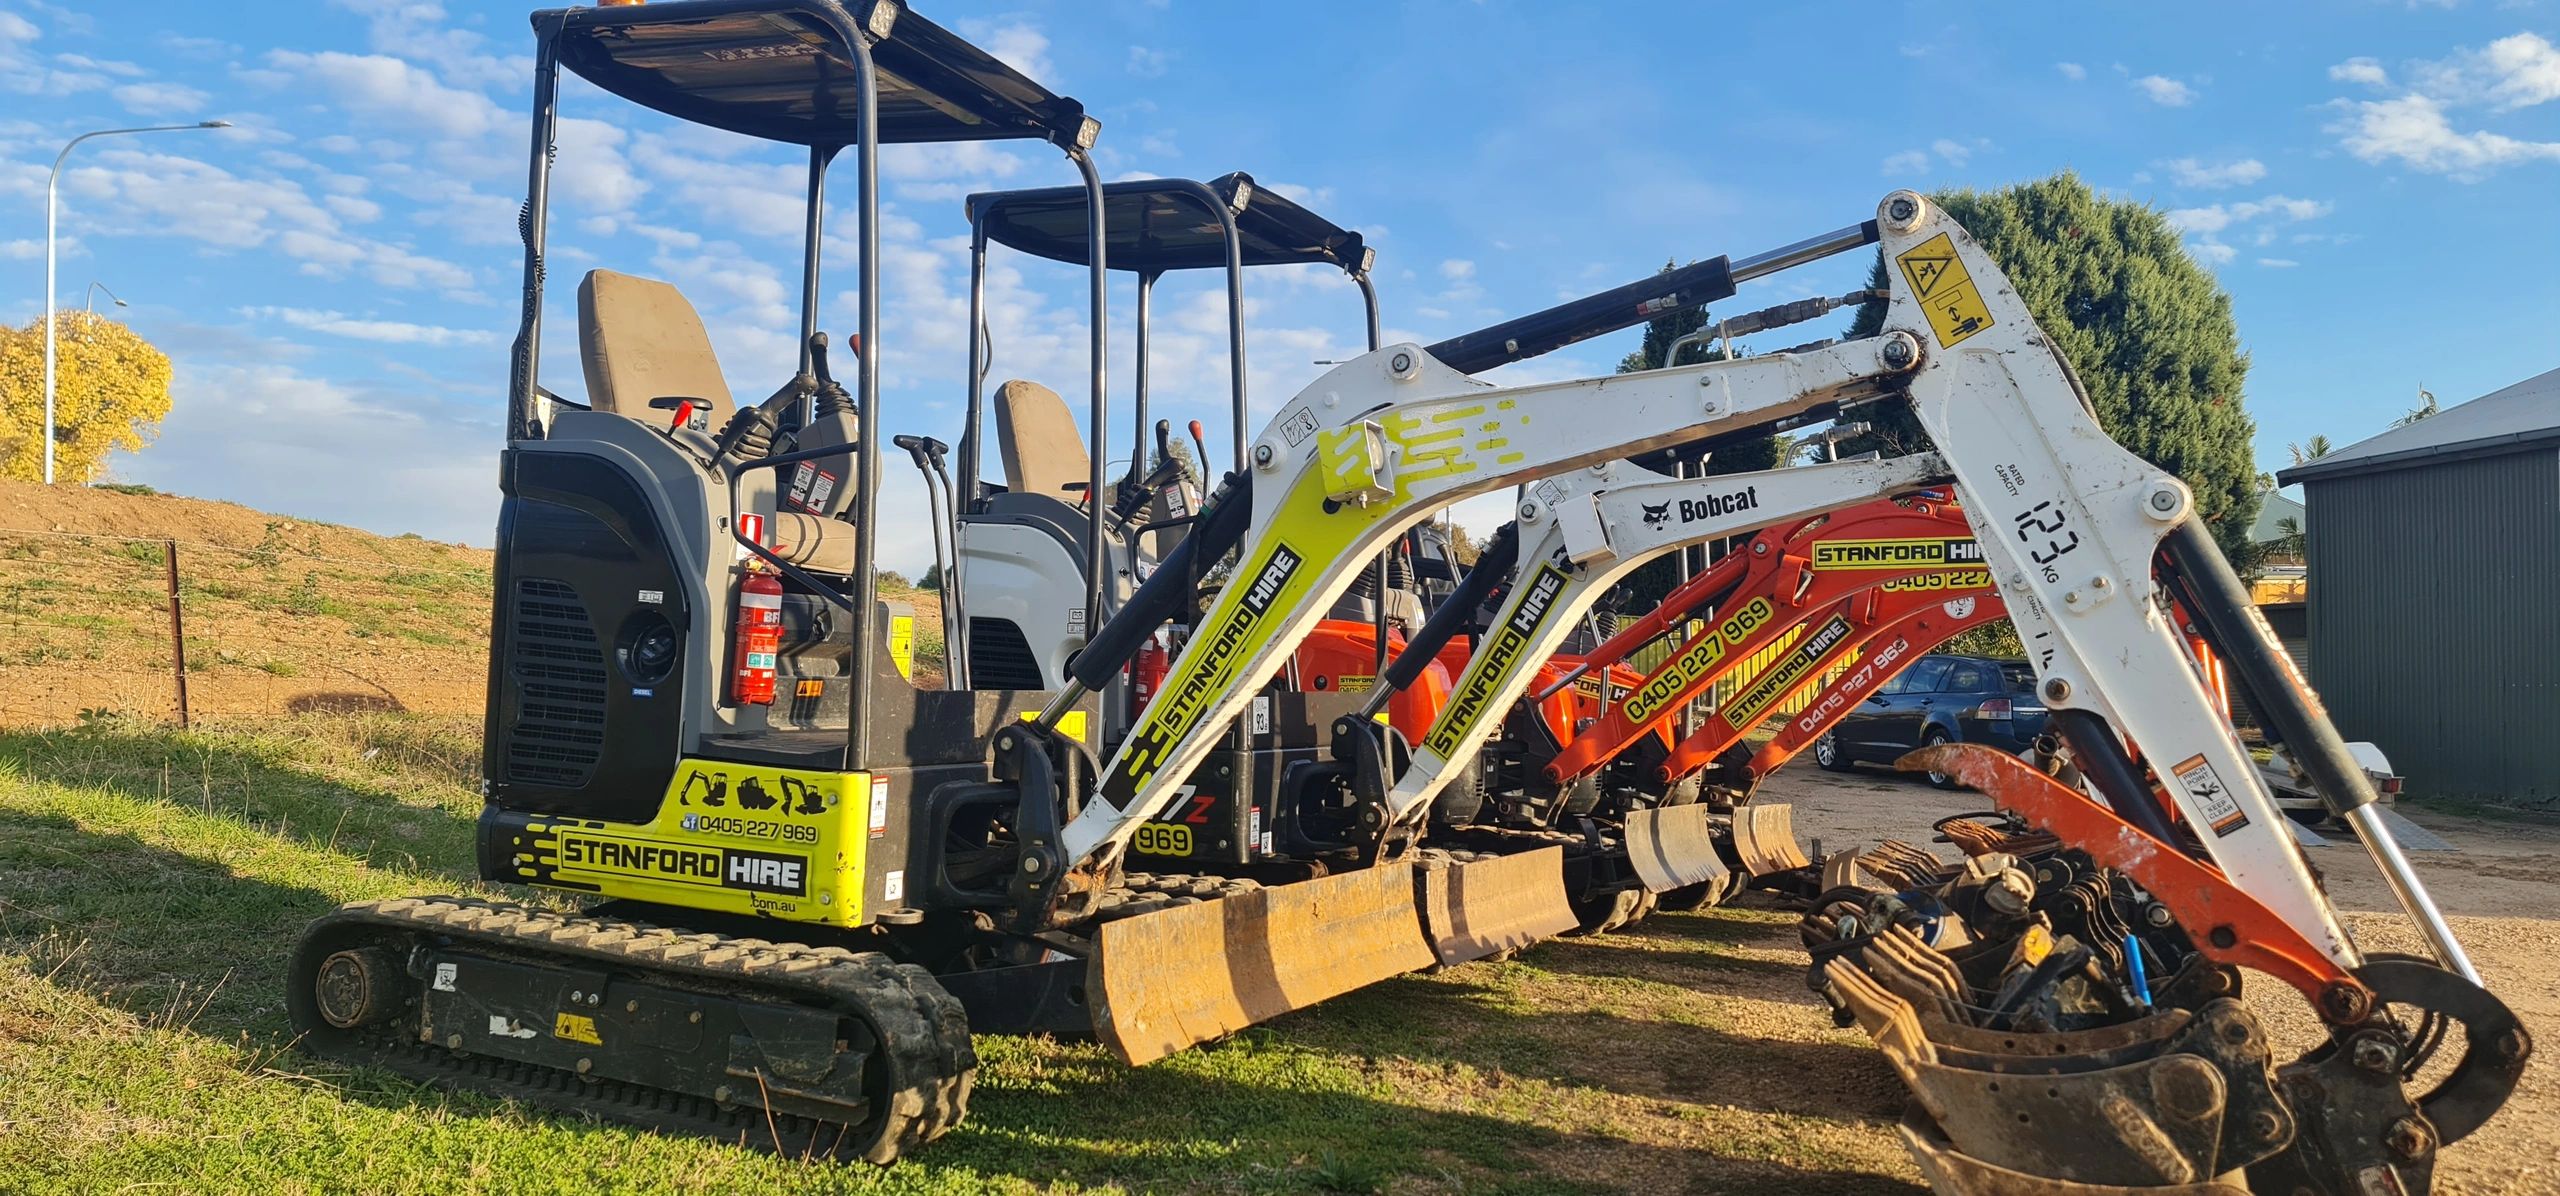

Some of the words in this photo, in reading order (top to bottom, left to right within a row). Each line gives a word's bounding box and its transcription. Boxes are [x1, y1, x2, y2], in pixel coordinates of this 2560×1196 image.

[1994, 464, 2019, 497] CAPACITY
[2008, 463, 2025, 487] RATED
[1679, 486, 1758, 523] Bobcat
[2015, 501, 2079, 565] 123
[1818, 545, 1943, 562] STANFORD
[1950, 543, 1981, 559] HI
[1884, 573, 1943, 589] 0405
[2041, 565, 2059, 584] KG
[1164, 608, 1254, 729] STANFORD
[1248, 551, 1294, 609] HIRE
[1434, 631, 1520, 754] STANFORD
[1514, 573, 1560, 631] HIRE
[1627, 672, 1683, 721] 0405
[1680, 635, 1720, 676] 227
[1723, 600, 1769, 641] 969
[1729, 655, 1808, 724] STANFORD
[1806, 620, 1845, 658] HIRE
[1799, 692, 1844, 733] 0405
[1841, 666, 1874, 695] 227
[1162, 785, 1216, 823] 7Z
[700, 816, 743, 834] 0405
[746, 821, 779, 839] 227
[782, 824, 817, 842] 969
[1138, 828, 1188, 851] 969
[563, 839, 721, 878] STANFORD
[729, 856, 801, 889] HIRE
[749, 898, 796, 913] .com.au
